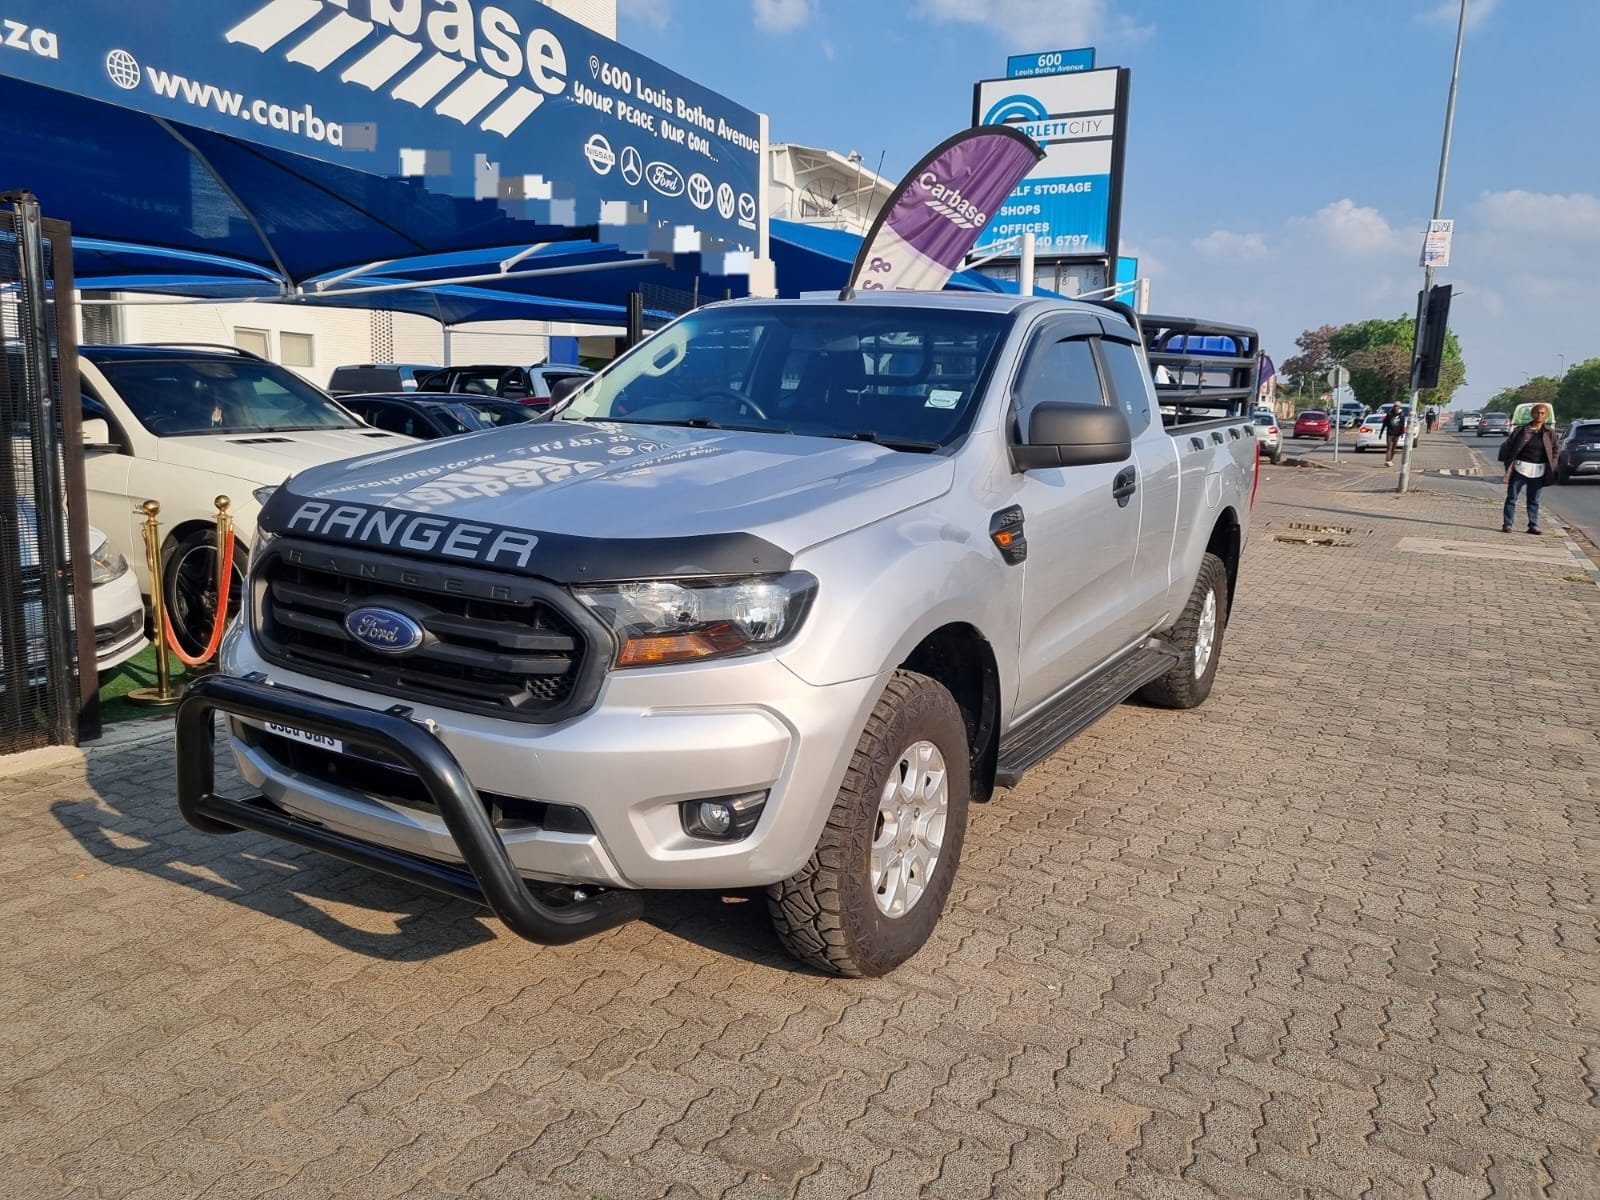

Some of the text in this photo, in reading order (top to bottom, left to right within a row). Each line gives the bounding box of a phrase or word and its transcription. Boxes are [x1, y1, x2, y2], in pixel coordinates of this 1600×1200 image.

[1034, 66, 1056, 74] Botha
[1057, 63, 1084, 72] Avenue
[1038, 53, 1062, 67] 600
[601, 63, 760, 154] 600 Louis Botha Avenue
[661, 120, 685, 145] OUR
[652, 166, 679, 191] Ford
[1034, 182, 1092, 195] STORAGE
[920, 172, 987, 228] Carbase
[1000, 205, 1041, 216] SHOPS
[999, 222, 1050, 234] OFFICES
[1056, 234, 1088, 247] 6797
[287, 501, 539, 568] RANGER
[288, 548, 513, 600] RANGER
[357, 614, 399, 643] Ford
